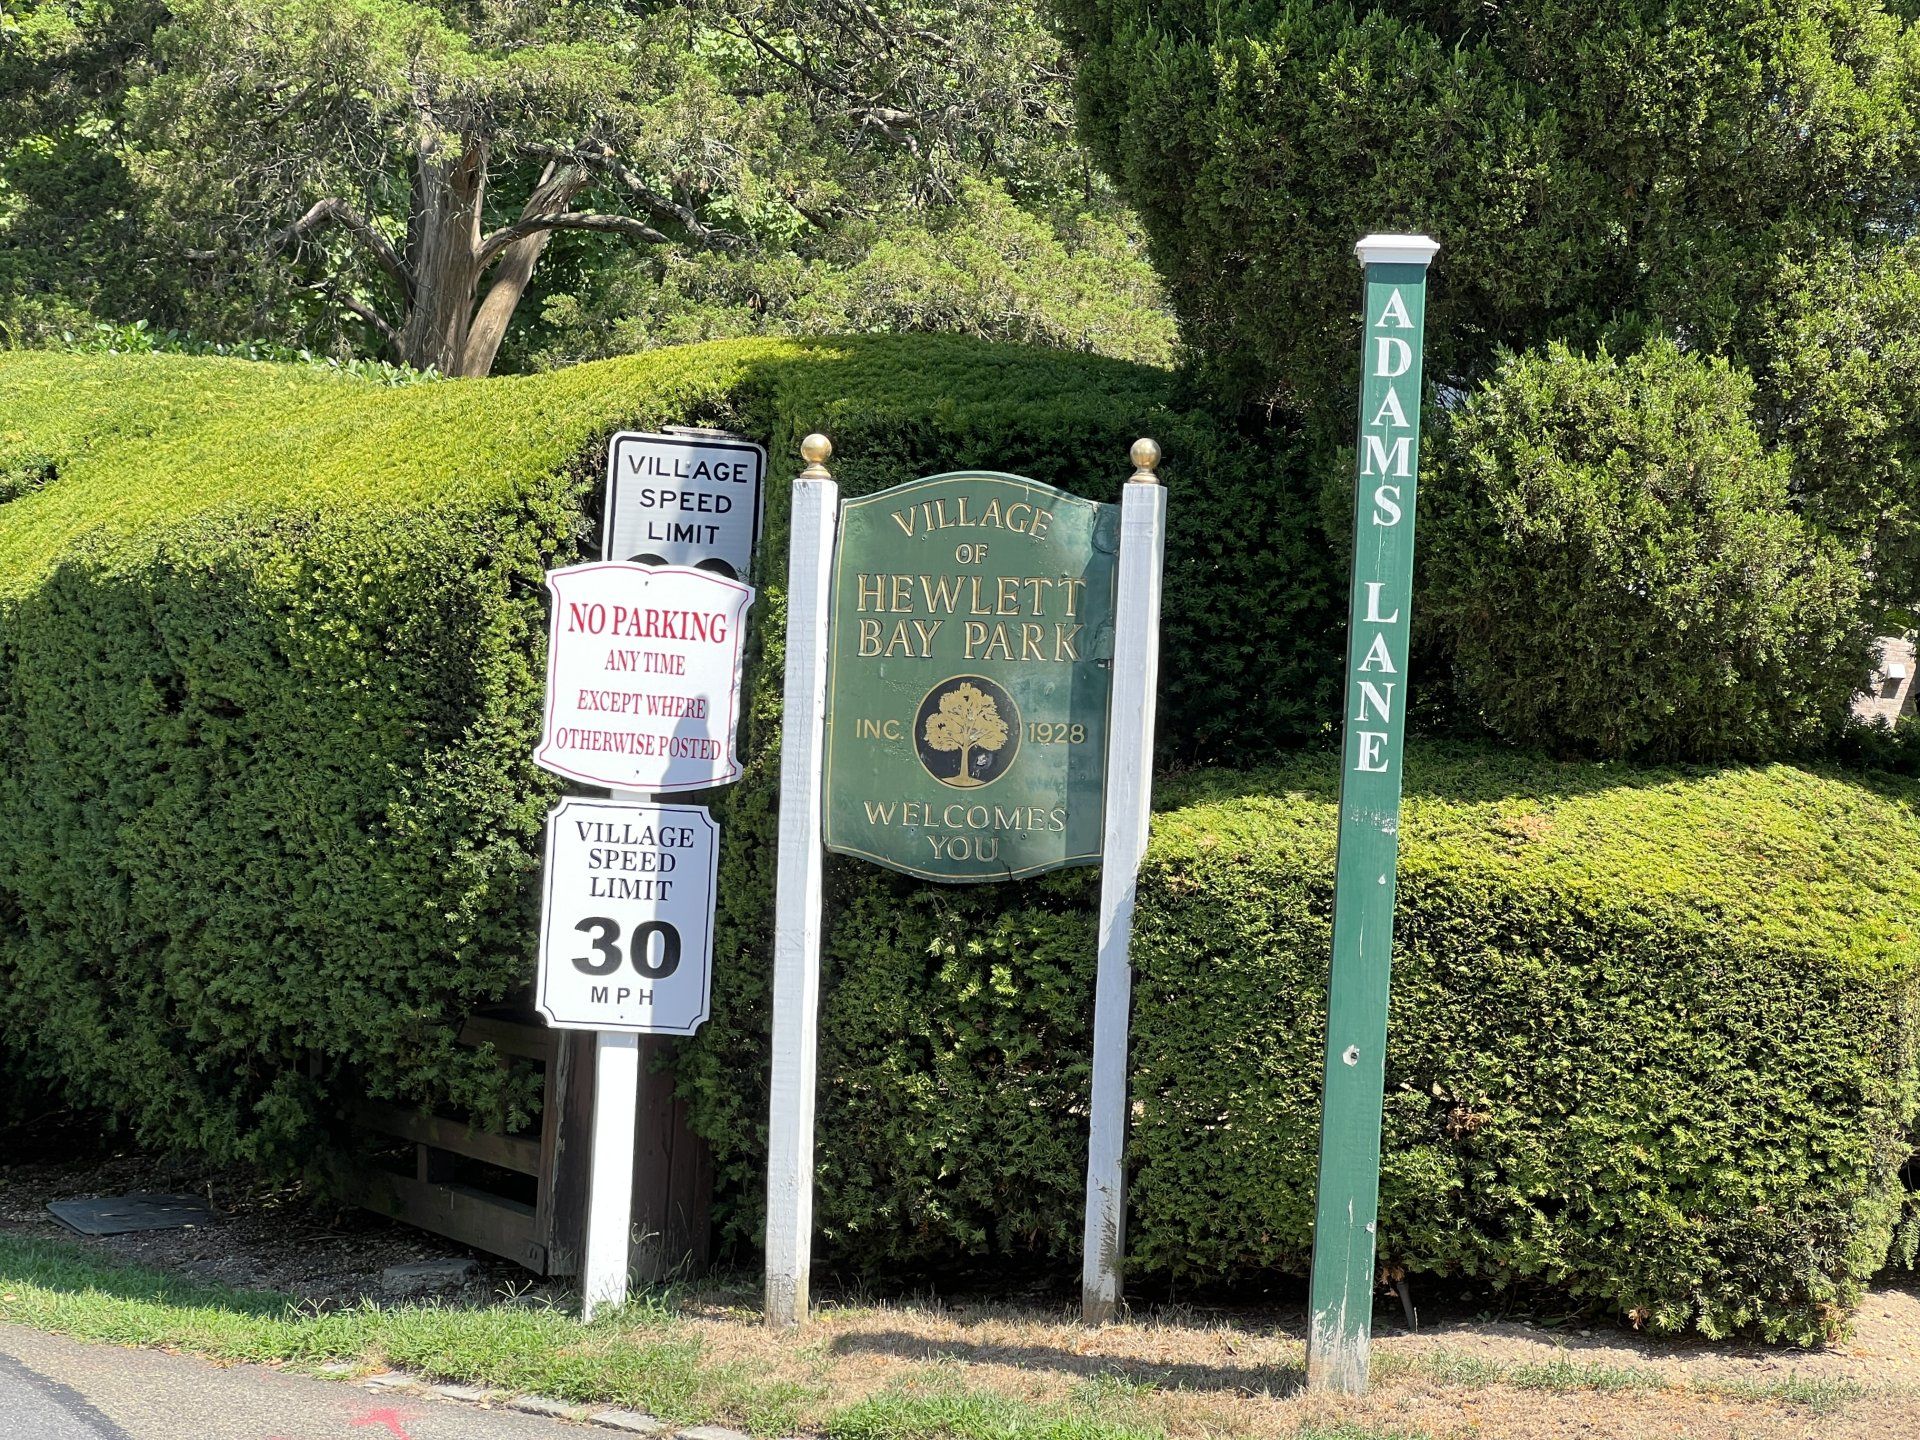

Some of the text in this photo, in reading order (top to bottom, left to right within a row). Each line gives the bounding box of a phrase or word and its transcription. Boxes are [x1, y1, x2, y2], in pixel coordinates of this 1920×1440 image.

[628, 455, 748, 483] VILLAGE
[640, 489, 732, 513] SPEED
[648, 521, 720, 545] LIMIT
[891, 497, 1054, 541] VILLAGE
[1353, 288, 1415, 773] ADAMS LANE
[955, 542, 989, 564] OF
[856, 573, 1087, 616] HEWLETT
[568, 603, 727, 643] NO PARKING
[857, 618, 1085, 662] BAY PARK
[577, 689, 706, 719] EXCEPT WHERE
[556, 728, 721, 760] OTHERWISE POSTED
[856, 719, 1085, 744] INC. 1928
[863, 801, 1067, 832] WELCOMES
[575, 821, 694, 848] VILLAGE
[927, 835, 999, 862] YOU
[589, 849, 676, 872] SPEED
[589, 877, 672, 901] LIMIT
[571, 917, 681, 979] 30
[591, 986, 653, 1005] MPH
